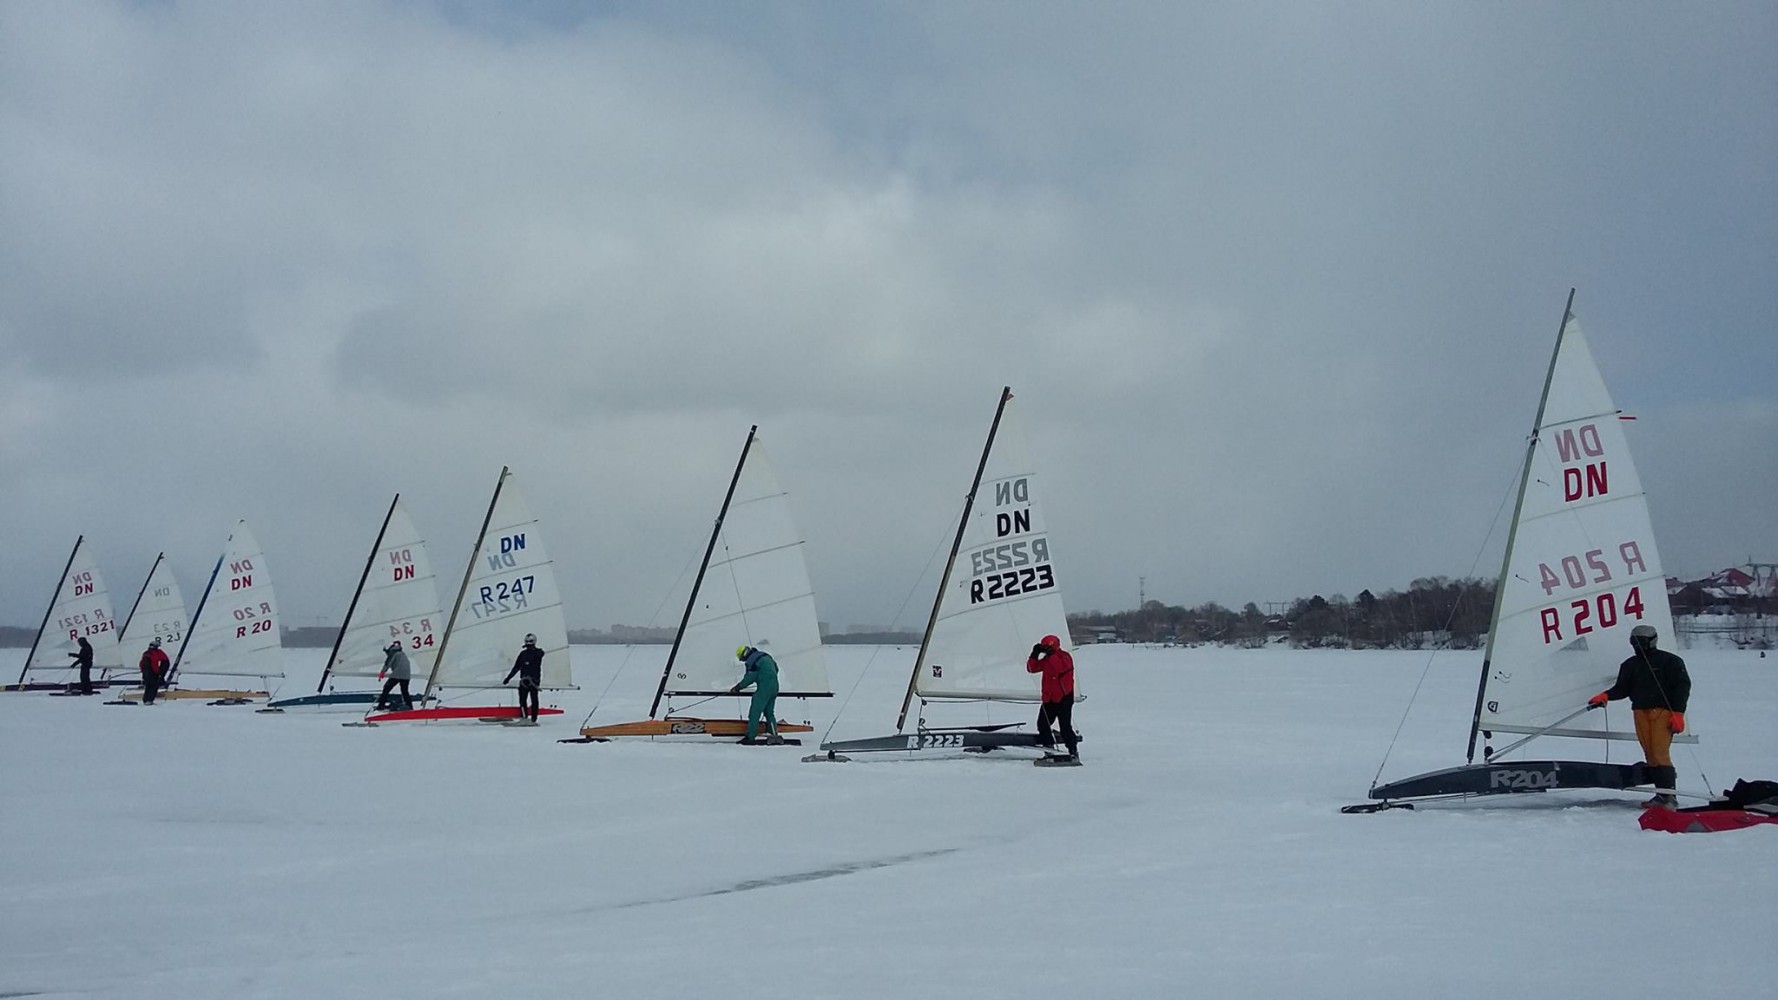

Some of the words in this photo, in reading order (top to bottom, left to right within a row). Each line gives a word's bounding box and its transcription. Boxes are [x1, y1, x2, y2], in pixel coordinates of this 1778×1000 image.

[1564, 461, 1608, 502] DN
[997, 509, 1030, 537] DN
[501, 533, 525, 554] DN
[394, 564, 414, 581] DN
[75, 582, 93, 596] DN
[231, 574, 252, 591] DN
[1540, 608, 1563, 644] R
[1571, 586, 1644, 635] 204
[69, 629, 78, 640] R
[85, 619, 114, 636] 1321
[236, 626, 246, 638] R
[252, 619, 271, 634] 20
[412, 633, 434, 649] 34
[907, 736, 919, 748] R
[923, 735, 964, 748] 2223
